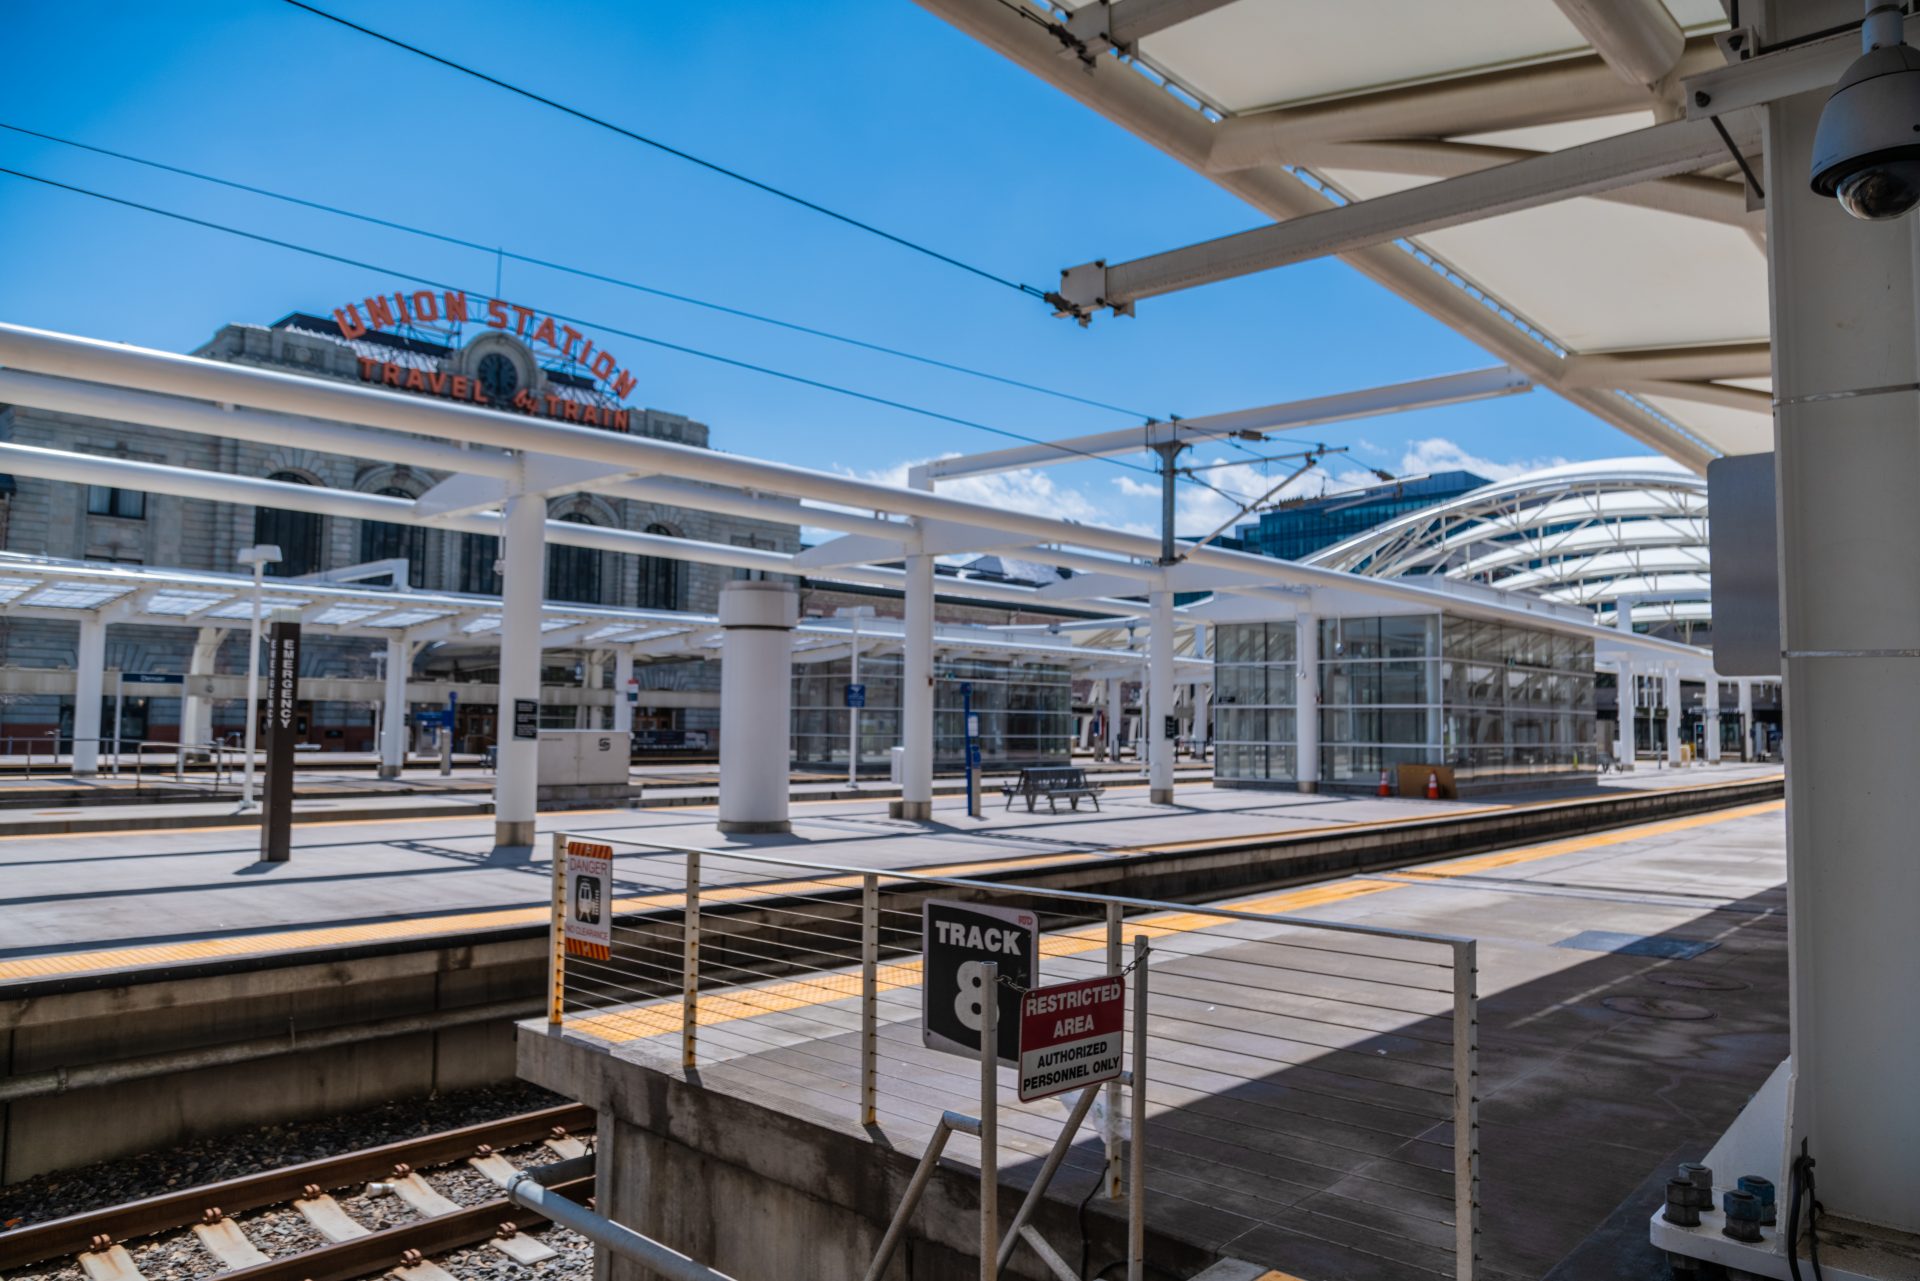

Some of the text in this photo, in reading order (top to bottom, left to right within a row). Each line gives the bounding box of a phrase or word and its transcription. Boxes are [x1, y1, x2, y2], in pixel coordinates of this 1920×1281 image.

[334, 291, 637, 399] UNION STATION
[358, 358, 488, 402] TRAVEL
[543, 396, 630, 432] TRAIN
[280, 639, 295, 728] EMERGENCY
[570, 857, 608, 875] DANGER
[935, 920, 1022, 956] TRACK
[954, 960, 1000, 1031] 8
[1025, 983, 1121, 1017] RESTRICTED
[1053, 1014, 1094, 1038] AREA
[1037, 1041, 1107, 1069] AUTHORIZED
[1023, 1056, 1120, 1092] PERSONNEL ONLY
